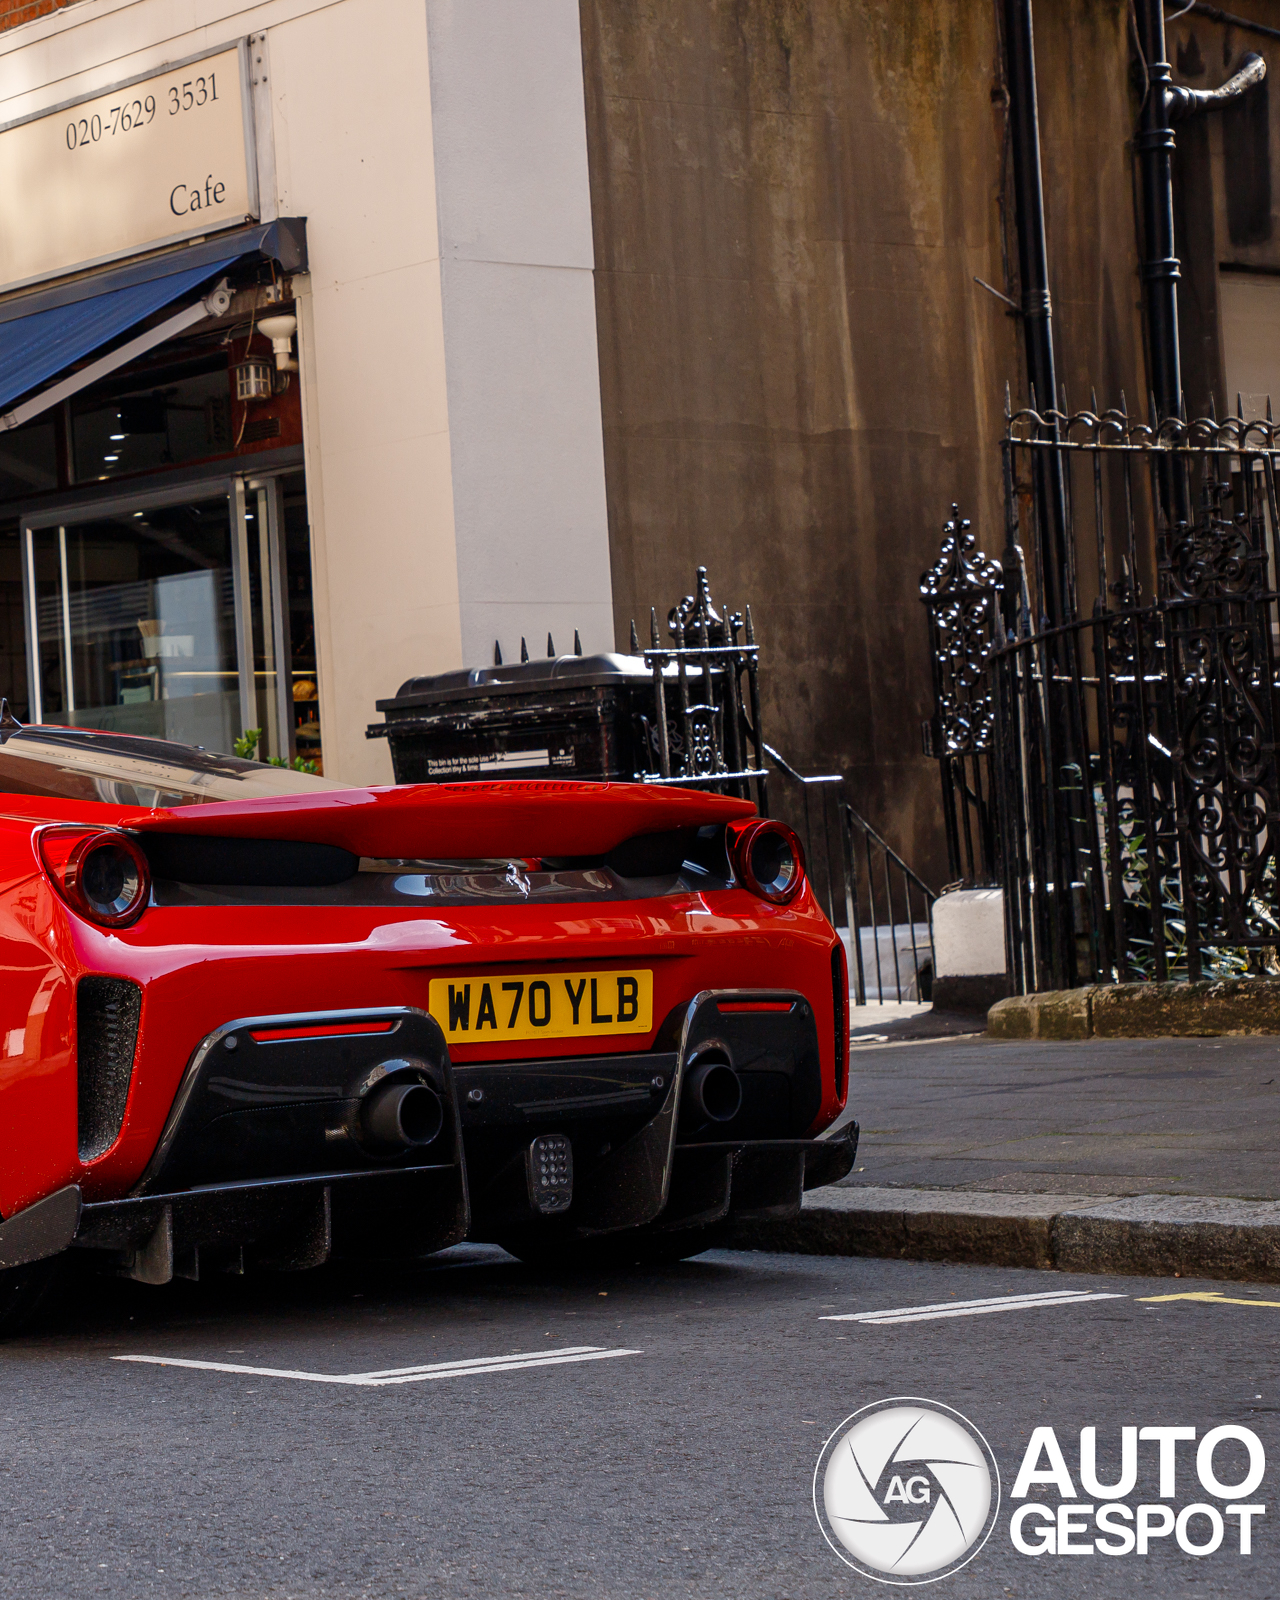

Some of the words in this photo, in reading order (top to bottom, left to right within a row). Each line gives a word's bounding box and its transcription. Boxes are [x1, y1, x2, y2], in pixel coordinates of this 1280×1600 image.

[66, 95, 156, 151] 020-7629
[168, 72, 220, 116] 3531
[169, 174, 226, 216] Cafe
[428, 766, 452, 775] Collection
[448, 980, 551, 1032] WA70
[564, 976, 639, 1025] YLB
